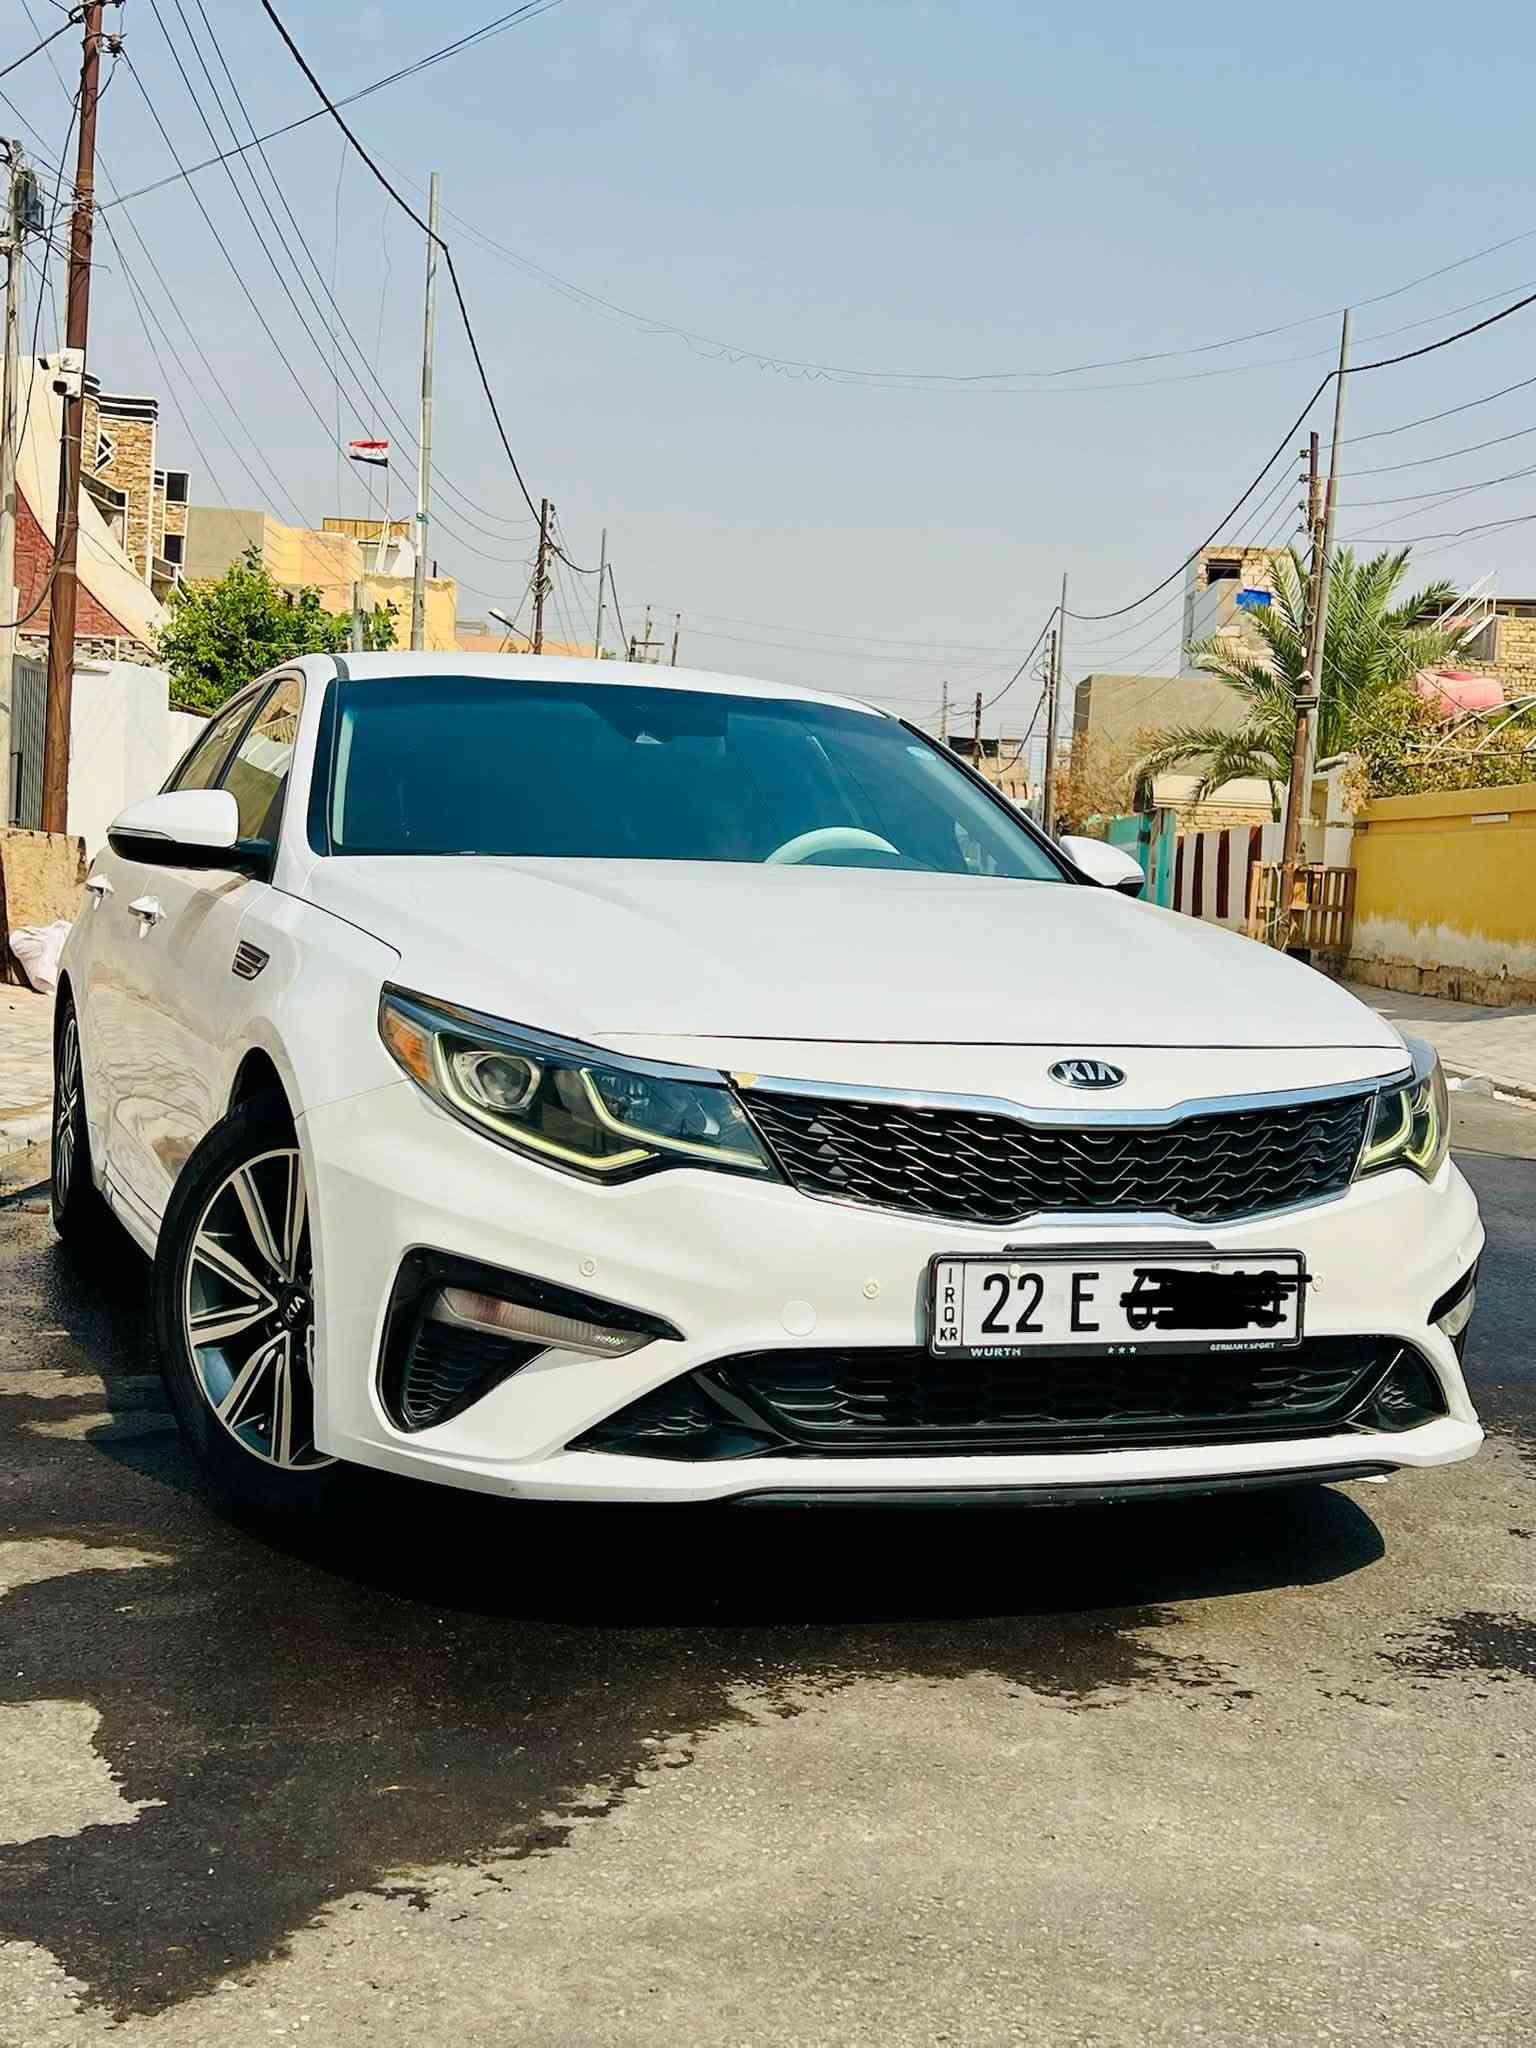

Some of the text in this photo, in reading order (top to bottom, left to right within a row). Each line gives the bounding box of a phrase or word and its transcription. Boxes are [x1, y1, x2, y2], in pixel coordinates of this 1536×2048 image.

[1059, 1062, 1119, 1081] KIA
[981, 1273, 1044, 1333] 22
[1070, 1272, 1100, 1332] E
[940, 1327, 958, 1341] KR
